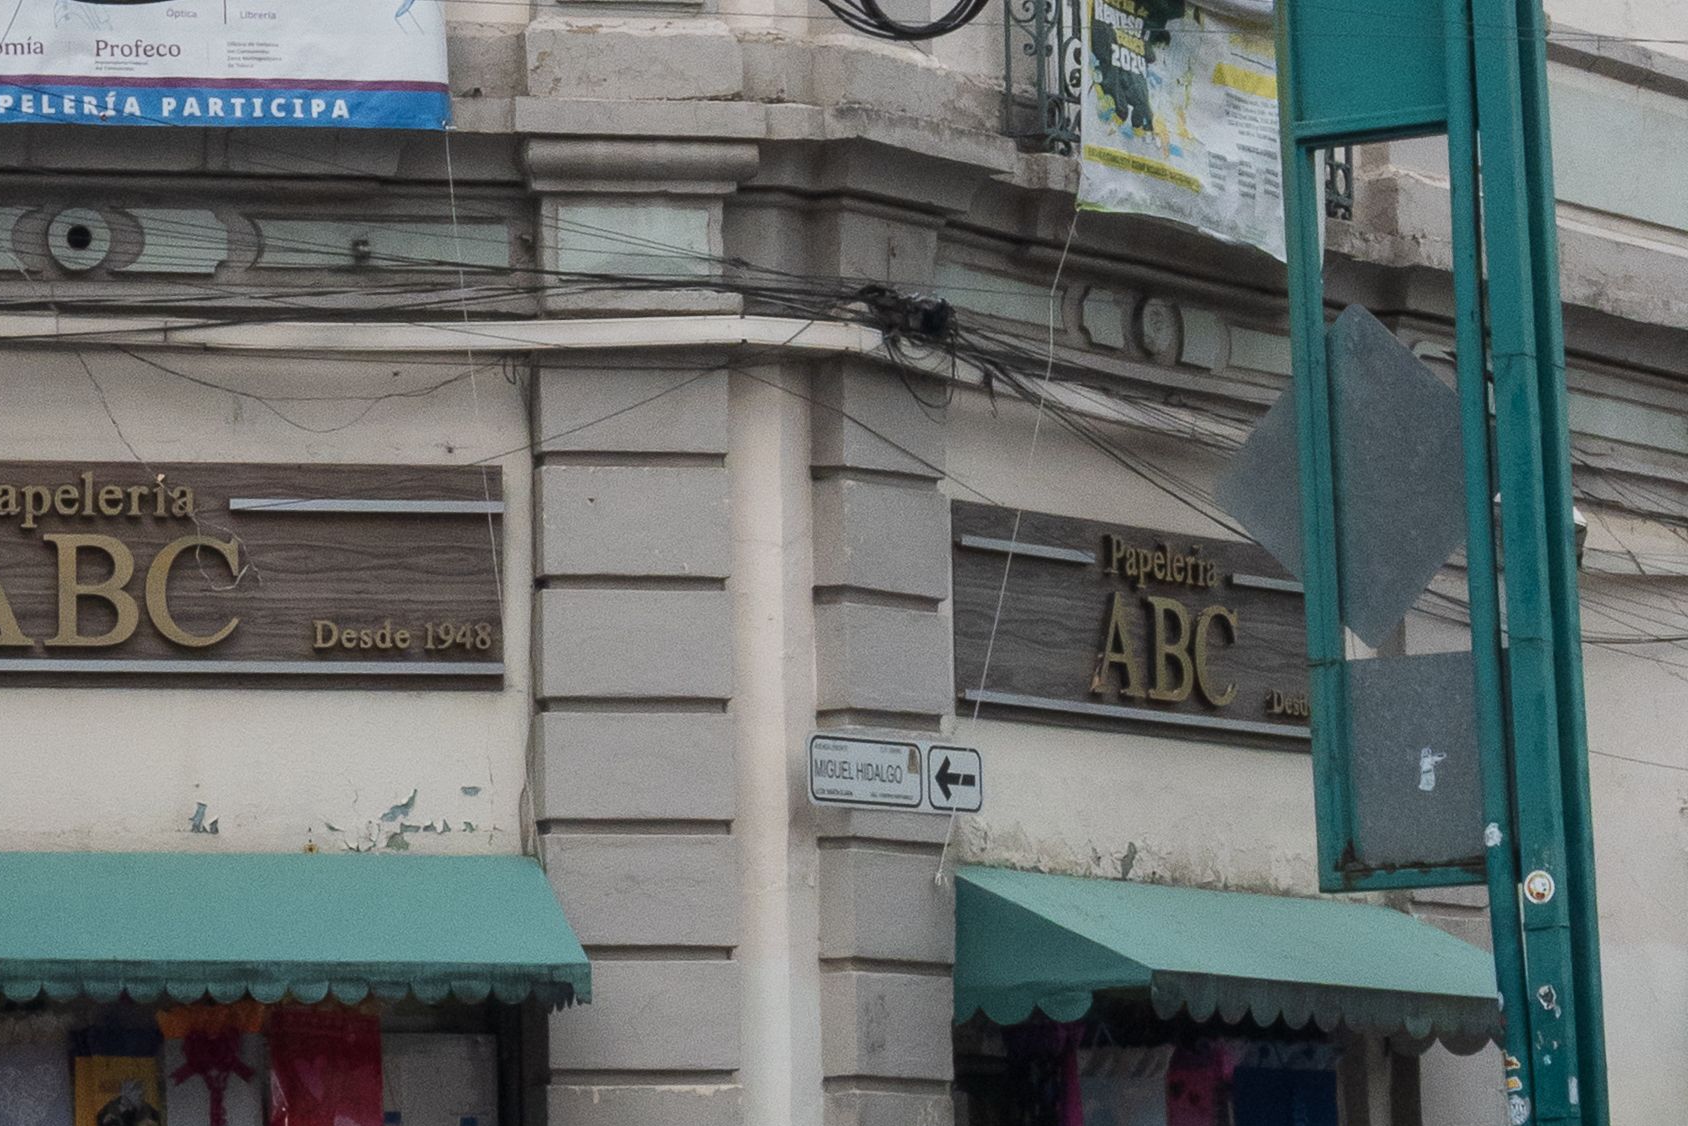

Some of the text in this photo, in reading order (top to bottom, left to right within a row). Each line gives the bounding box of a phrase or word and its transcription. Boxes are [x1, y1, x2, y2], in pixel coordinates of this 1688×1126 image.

[94, 38, 181, 58] Profeco
[1111, 43, 1147, 77] 2024
[162, 96, 350, 119] PARTICIPA
[1104, 534, 1220, 589] Papelería
[313, 618, 494, 651] Desde 1948
[1092, 591, 1239, 707] ABC
[814, 758, 904, 785] MIGUEL HIDALGO
